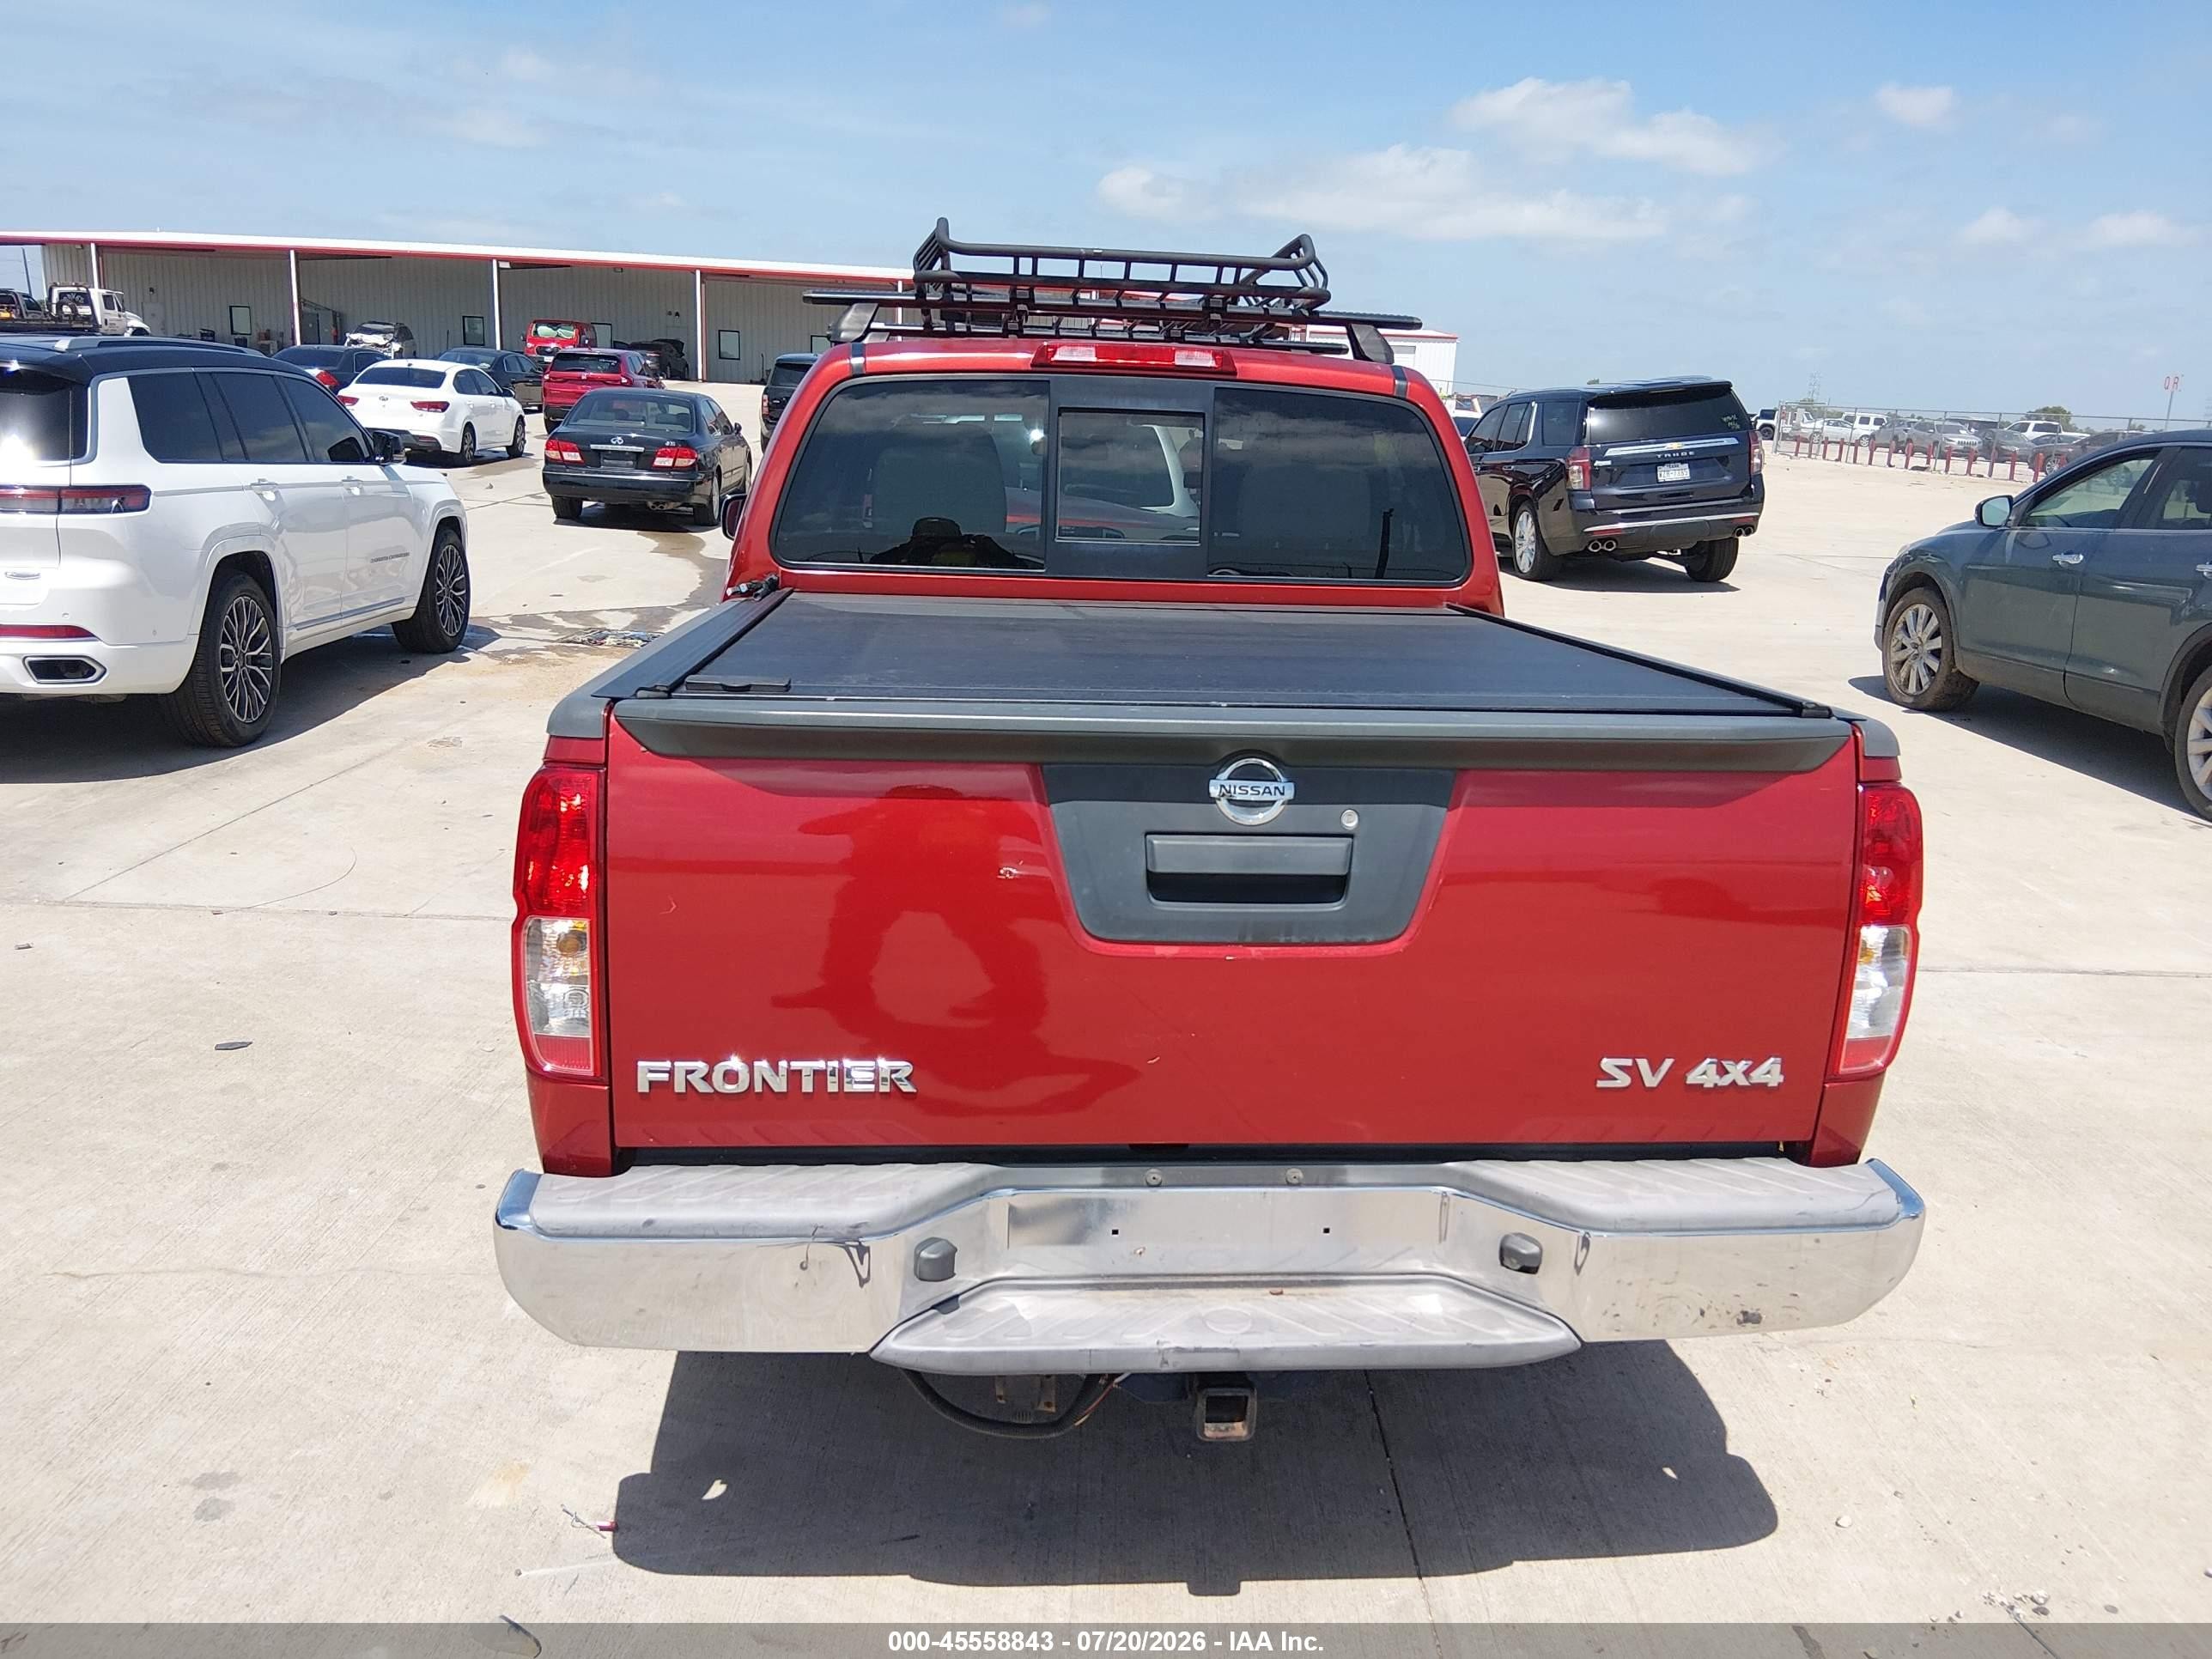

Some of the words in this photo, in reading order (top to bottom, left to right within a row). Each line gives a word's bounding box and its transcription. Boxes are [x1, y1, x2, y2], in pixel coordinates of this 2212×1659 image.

[1219, 784, 1285, 797] NISSAN
[637, 1059, 917, 1093] FRONTIER
[1595, 1057, 1675, 1088] SV
